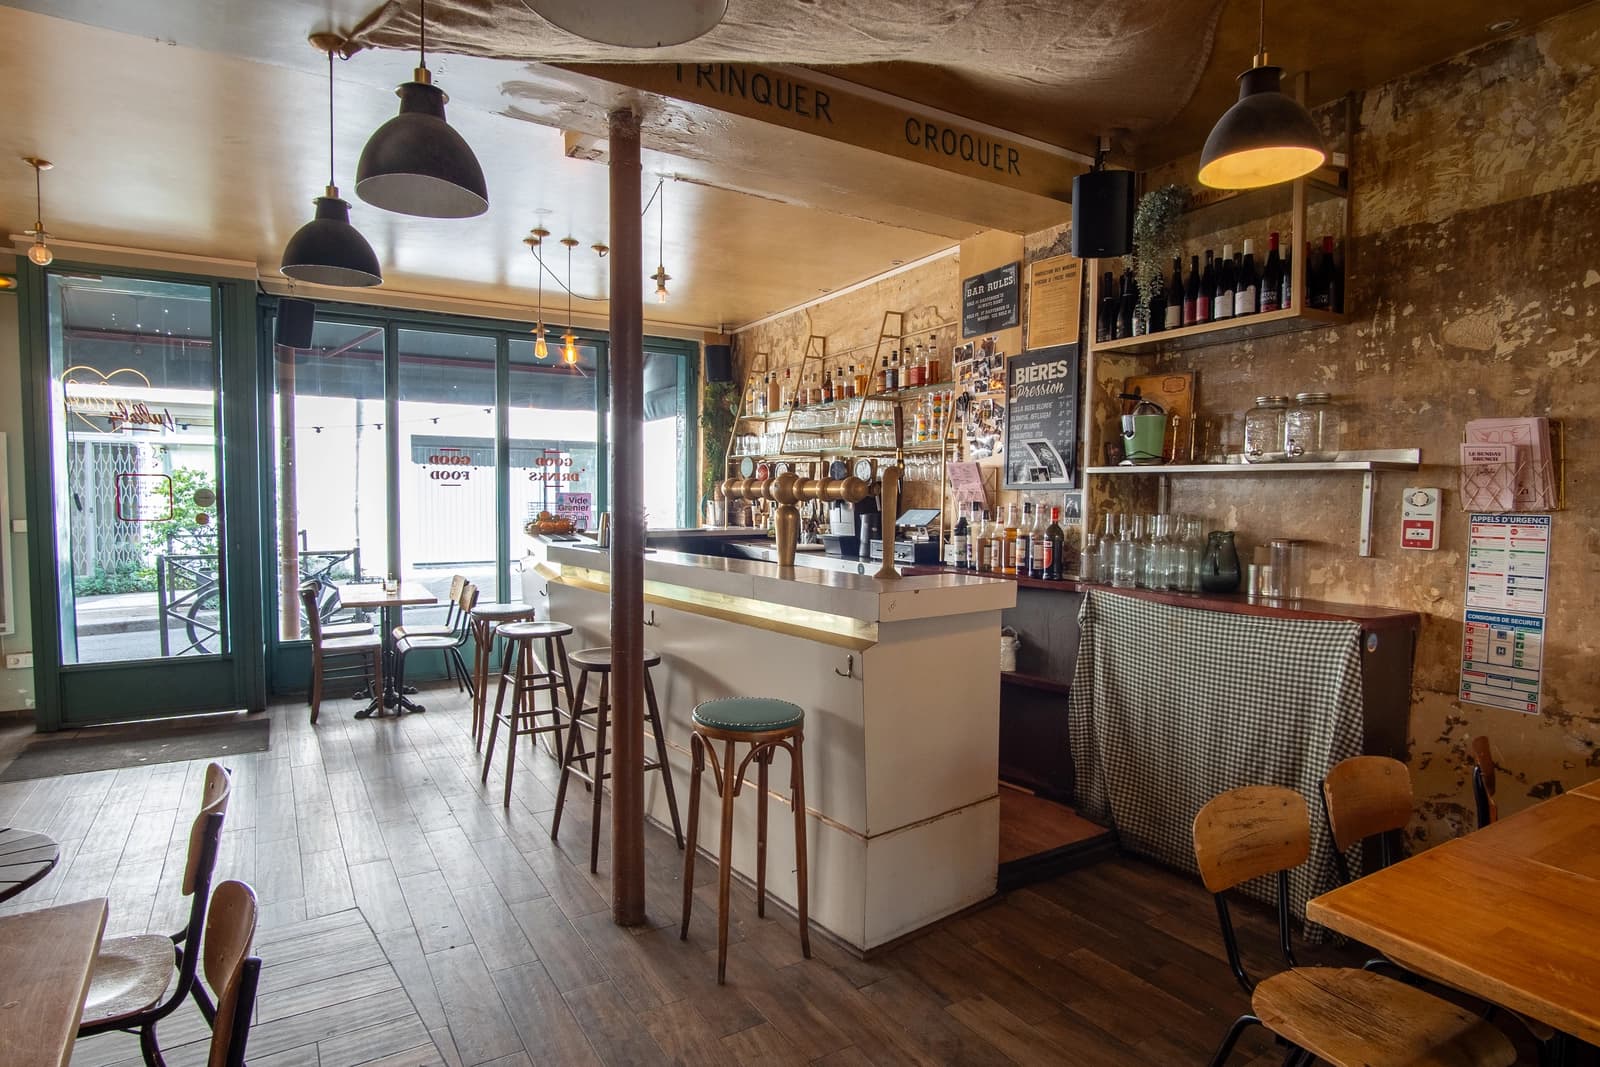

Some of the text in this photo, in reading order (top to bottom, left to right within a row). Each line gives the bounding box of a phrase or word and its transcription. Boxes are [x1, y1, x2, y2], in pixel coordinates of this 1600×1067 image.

[905, 117, 1021, 176] CROQUER
[967, 275, 1014, 298] BAR RULES
[1015, 360, 1068, 385] BIÈRES
[1016, 380, 1065, 398] Pression
[568, 496, 588, 504] Vide
[1471, 515, 1549, 524] APPELS D'URGENCE
[1467, 613, 1501, 622] CONSIGNES
